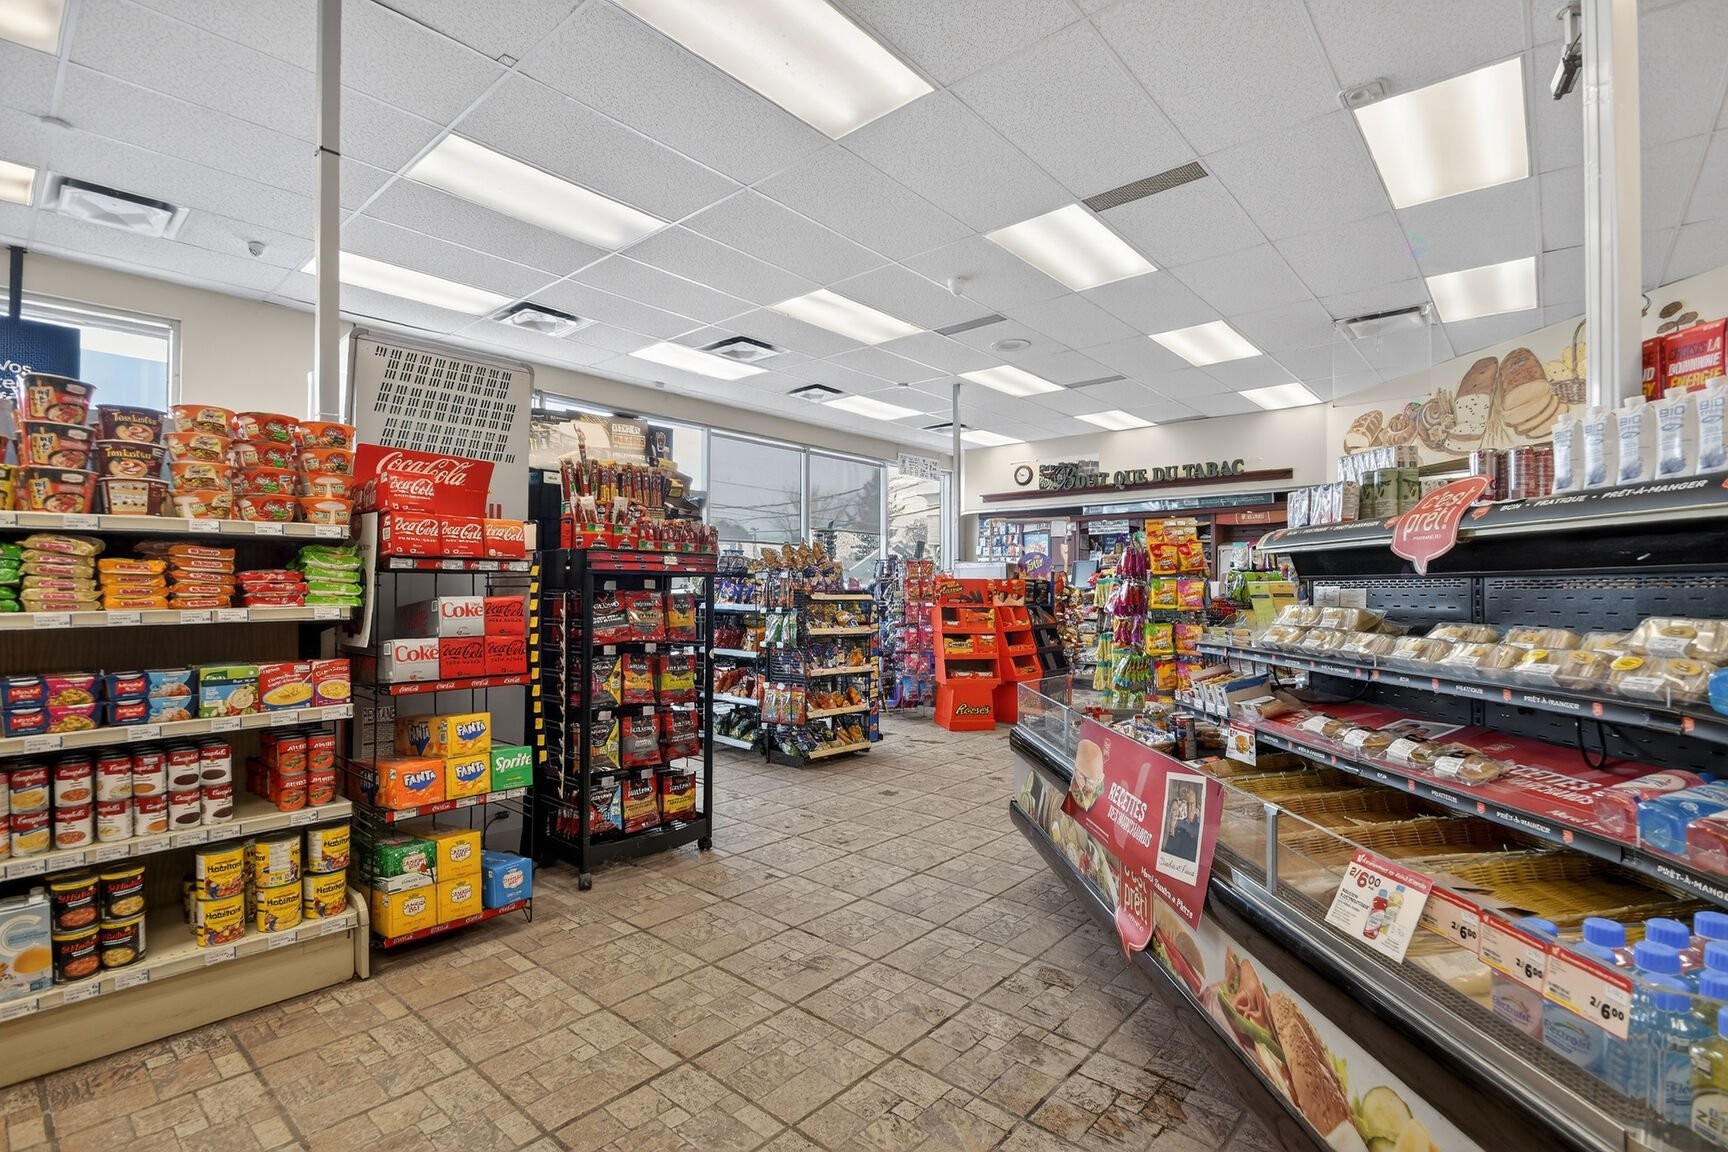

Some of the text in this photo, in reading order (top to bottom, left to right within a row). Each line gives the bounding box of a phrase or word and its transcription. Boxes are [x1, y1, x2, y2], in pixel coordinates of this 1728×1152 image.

[1707, 336, 1722, 352] LA
[376, 451, 474, 486] Coca-Cola
[1152, 465, 1179, 482] DU
[1182, 458, 1245, 479] TABAC
[1534, 494, 1588, 508] PRATIQUE
[1601, 479, 1709, 499] PRÊT-À-MANGER
[1403, 505, 1456, 542] prêt!
[441, 601, 484, 618] Coke
[395, 645, 440, 663] Coke
[456, 720, 486, 736] FANTA
[456, 760, 486, 778] FANTA
[495, 752, 532, 773] Sprite
[404, 769, 437, 786] FANTA
[1108, 782, 1148, 823] RECETTES
